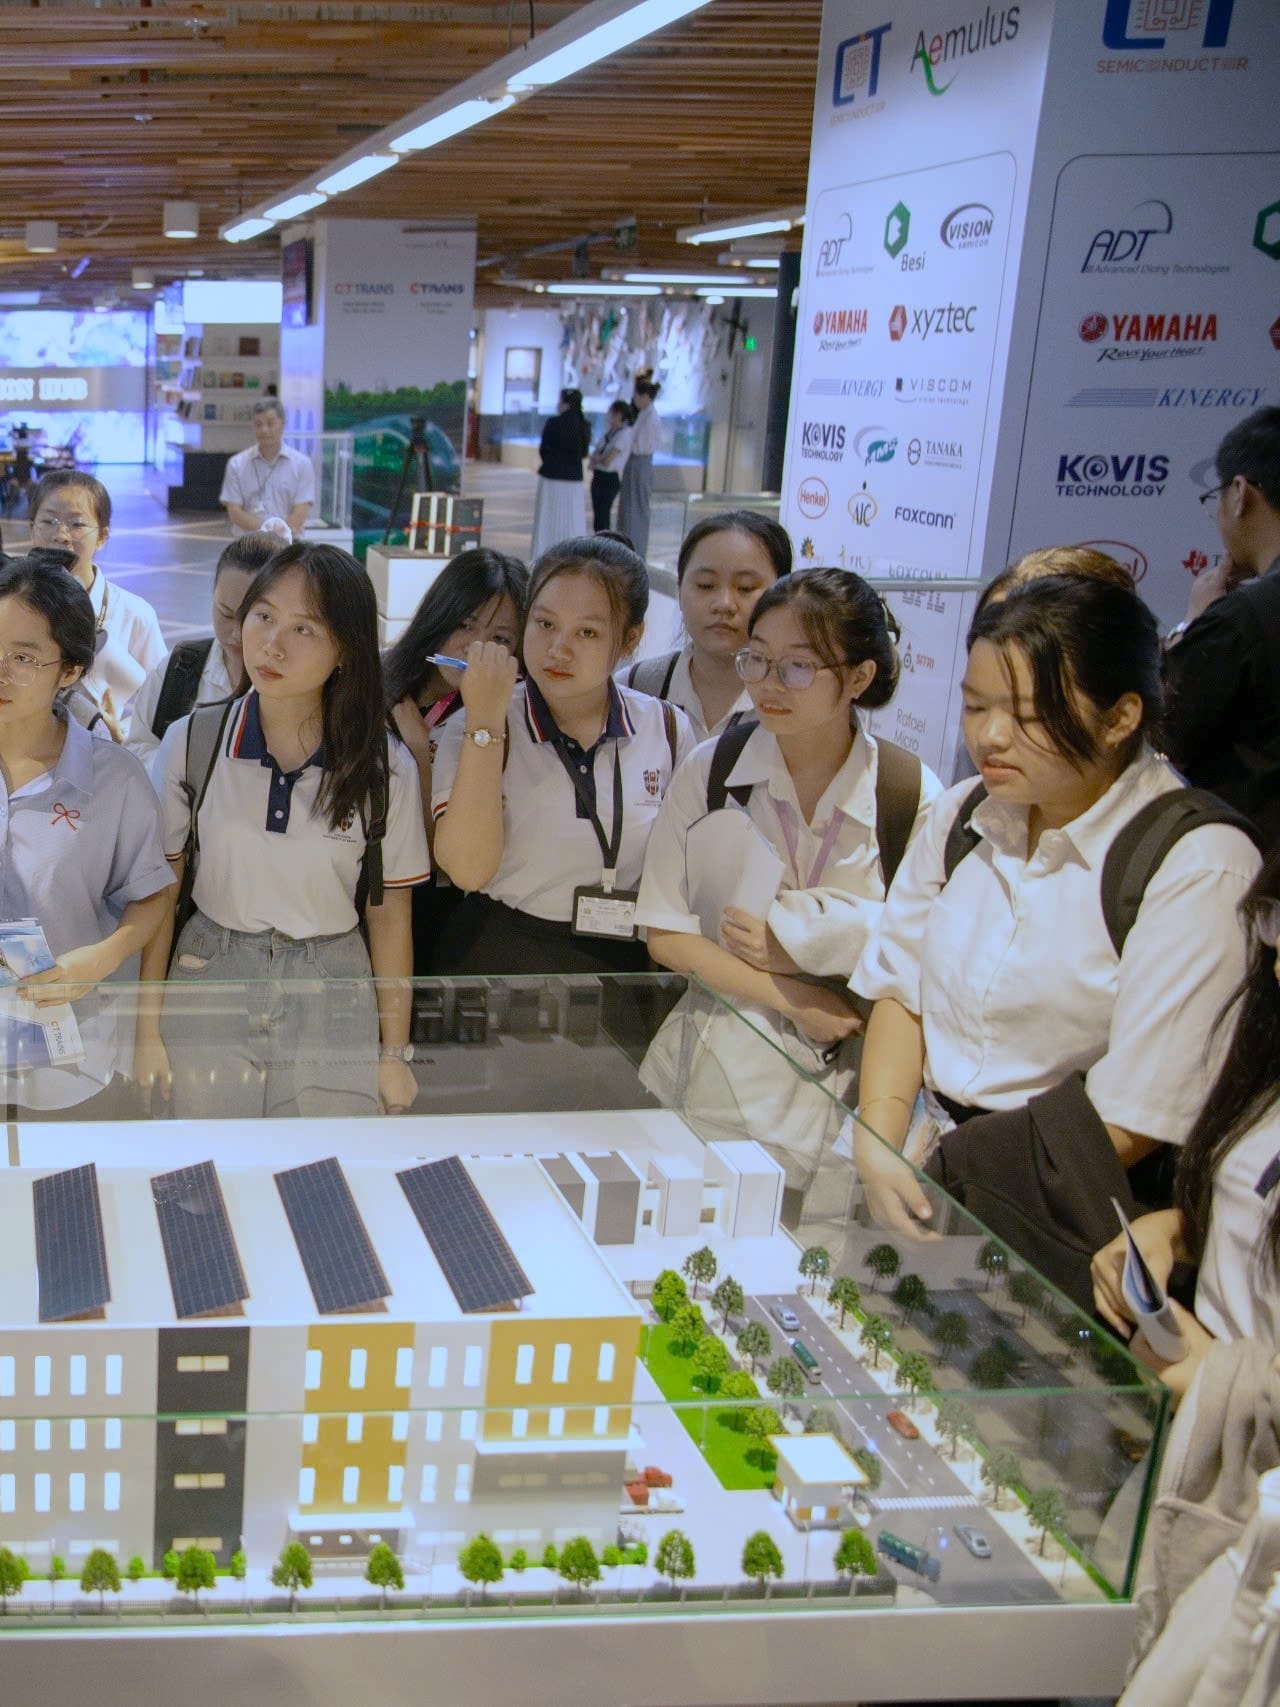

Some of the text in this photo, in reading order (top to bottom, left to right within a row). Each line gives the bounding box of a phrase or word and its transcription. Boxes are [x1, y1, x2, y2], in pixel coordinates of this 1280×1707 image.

[910, 5, 1020, 96] Aemulus
[949, 220, 993, 241] VISION
[901, 251, 927, 272] Besi
[1080, 229, 1160, 273] ADT
[825, 308, 868, 335] YAMAHA
[911, 302, 978, 341] xyztec
[1112, 314, 1218, 341] YAMAHA
[910, 378, 973, 393] VISCOM
[1158, 387, 1268, 408] KINERGY
[801, 447, 844, 463] TECHNOLOGY
[926, 440, 963, 458] TANAKA
[800, 487, 827, 507] Henkel
[1056, 484, 1166, 497] TECHNOLOGY
[897, 708, 926, 733] Rafael
[894, 729, 919, 752] Micro
